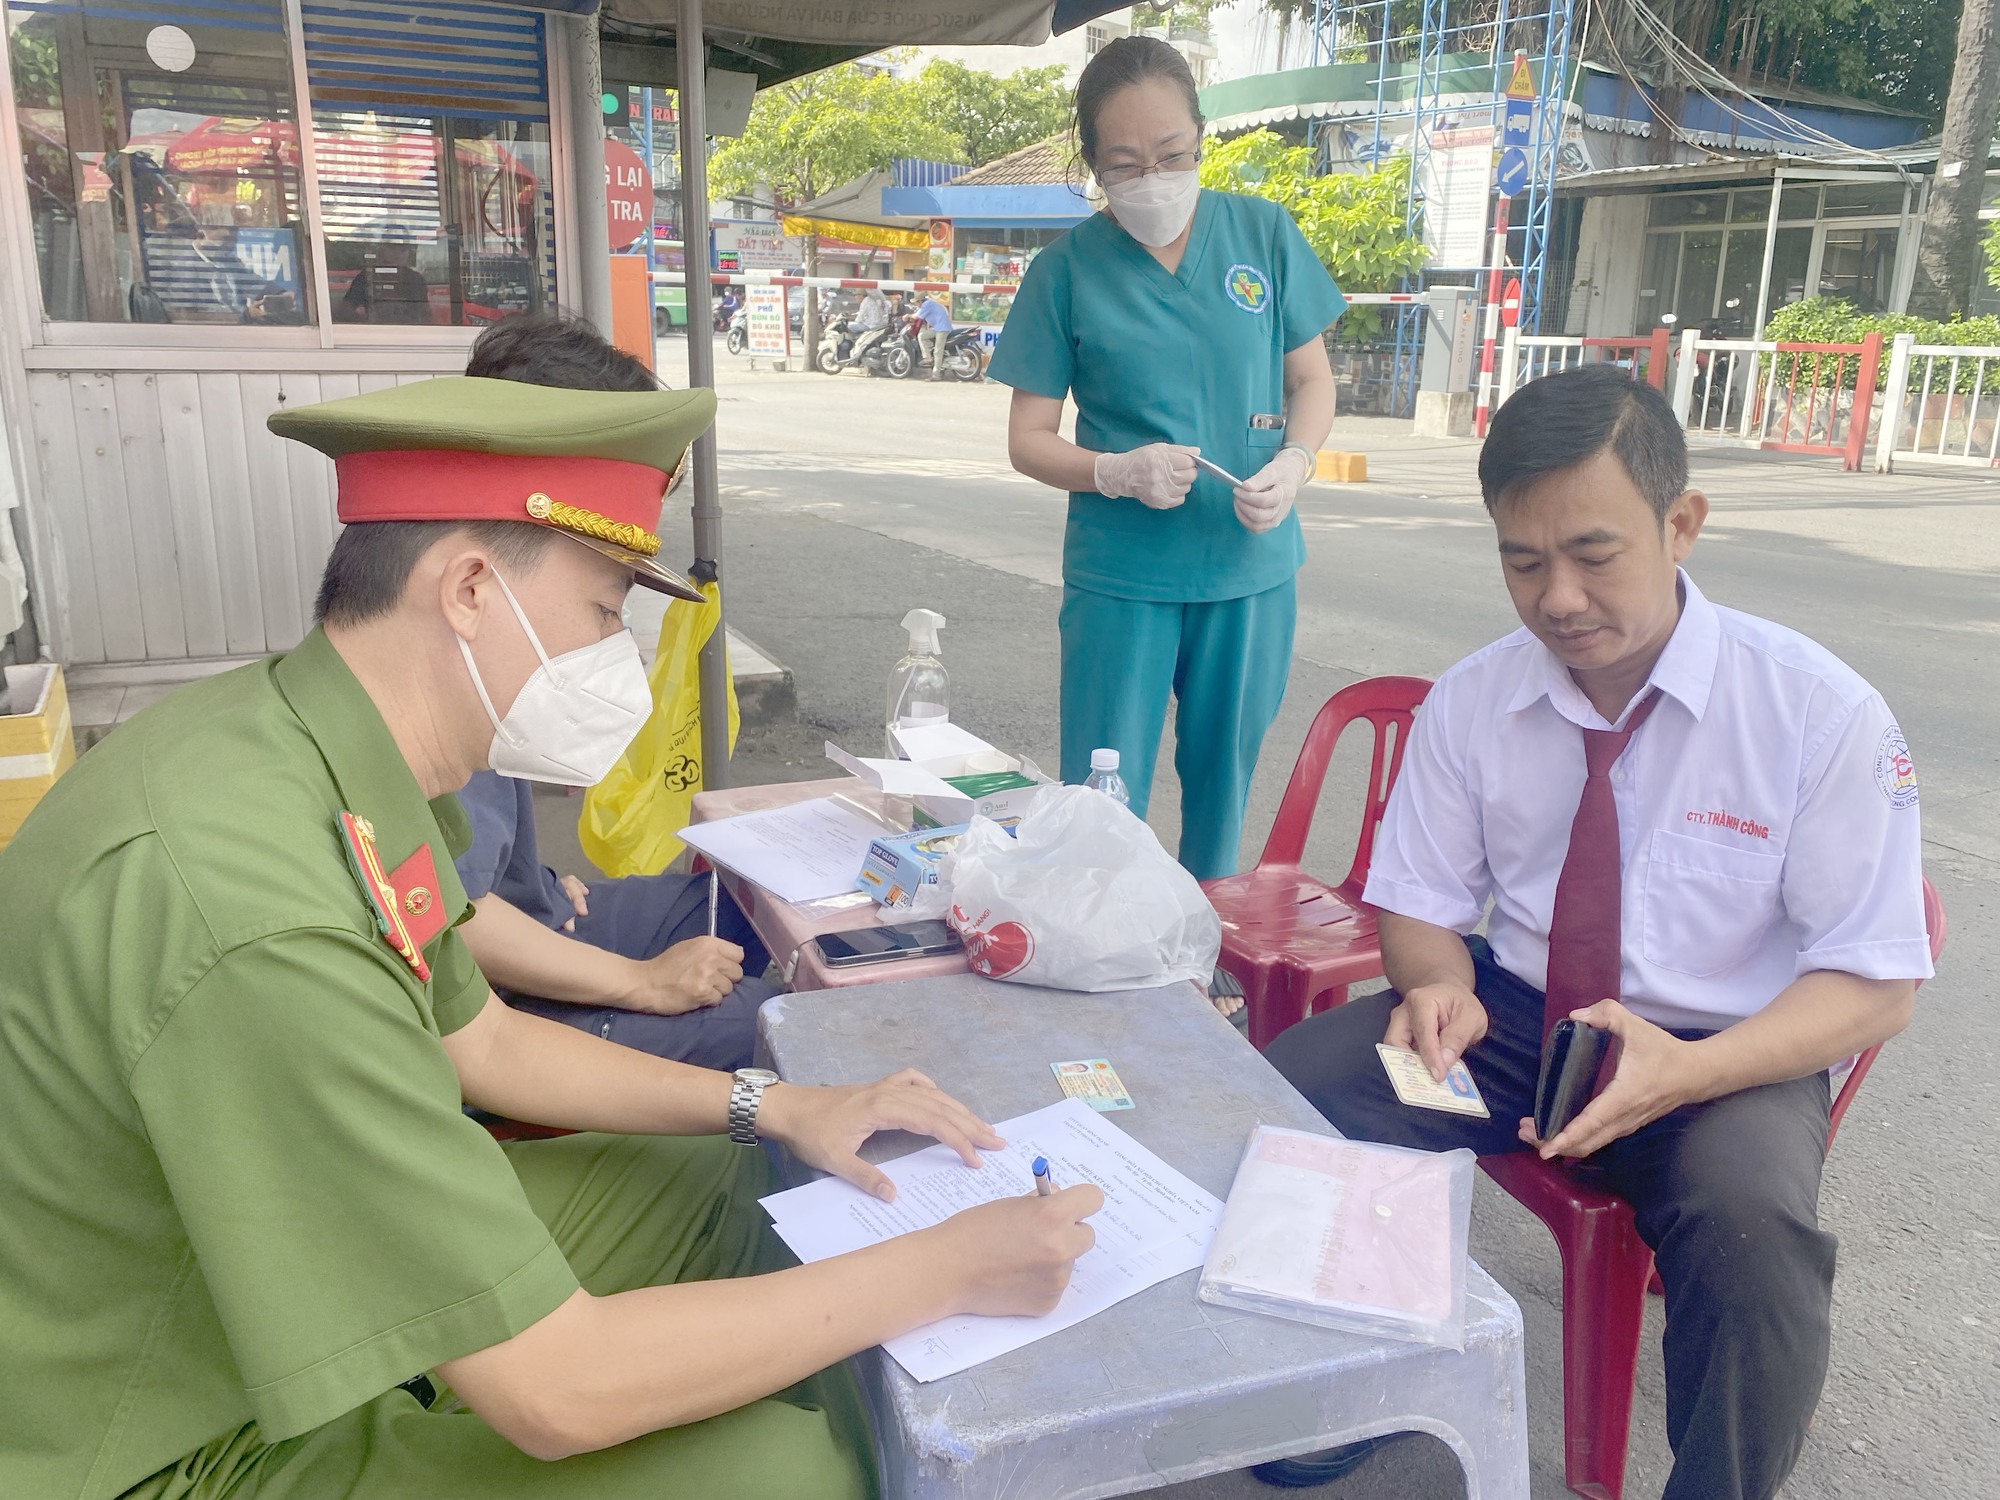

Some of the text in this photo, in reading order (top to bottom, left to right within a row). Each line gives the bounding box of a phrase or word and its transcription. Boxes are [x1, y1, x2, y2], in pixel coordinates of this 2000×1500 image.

[617, 166, 642, 191] LẠI
[611, 200, 643, 221] TRA
[1707, 809, 1740, 830] THÀNH
[1740, 819, 1770, 839] CÔNG
[872, 845, 883, 855] TOP
[882, 851, 899, 866] GLOVE
[899, 892, 909, 905] 100
